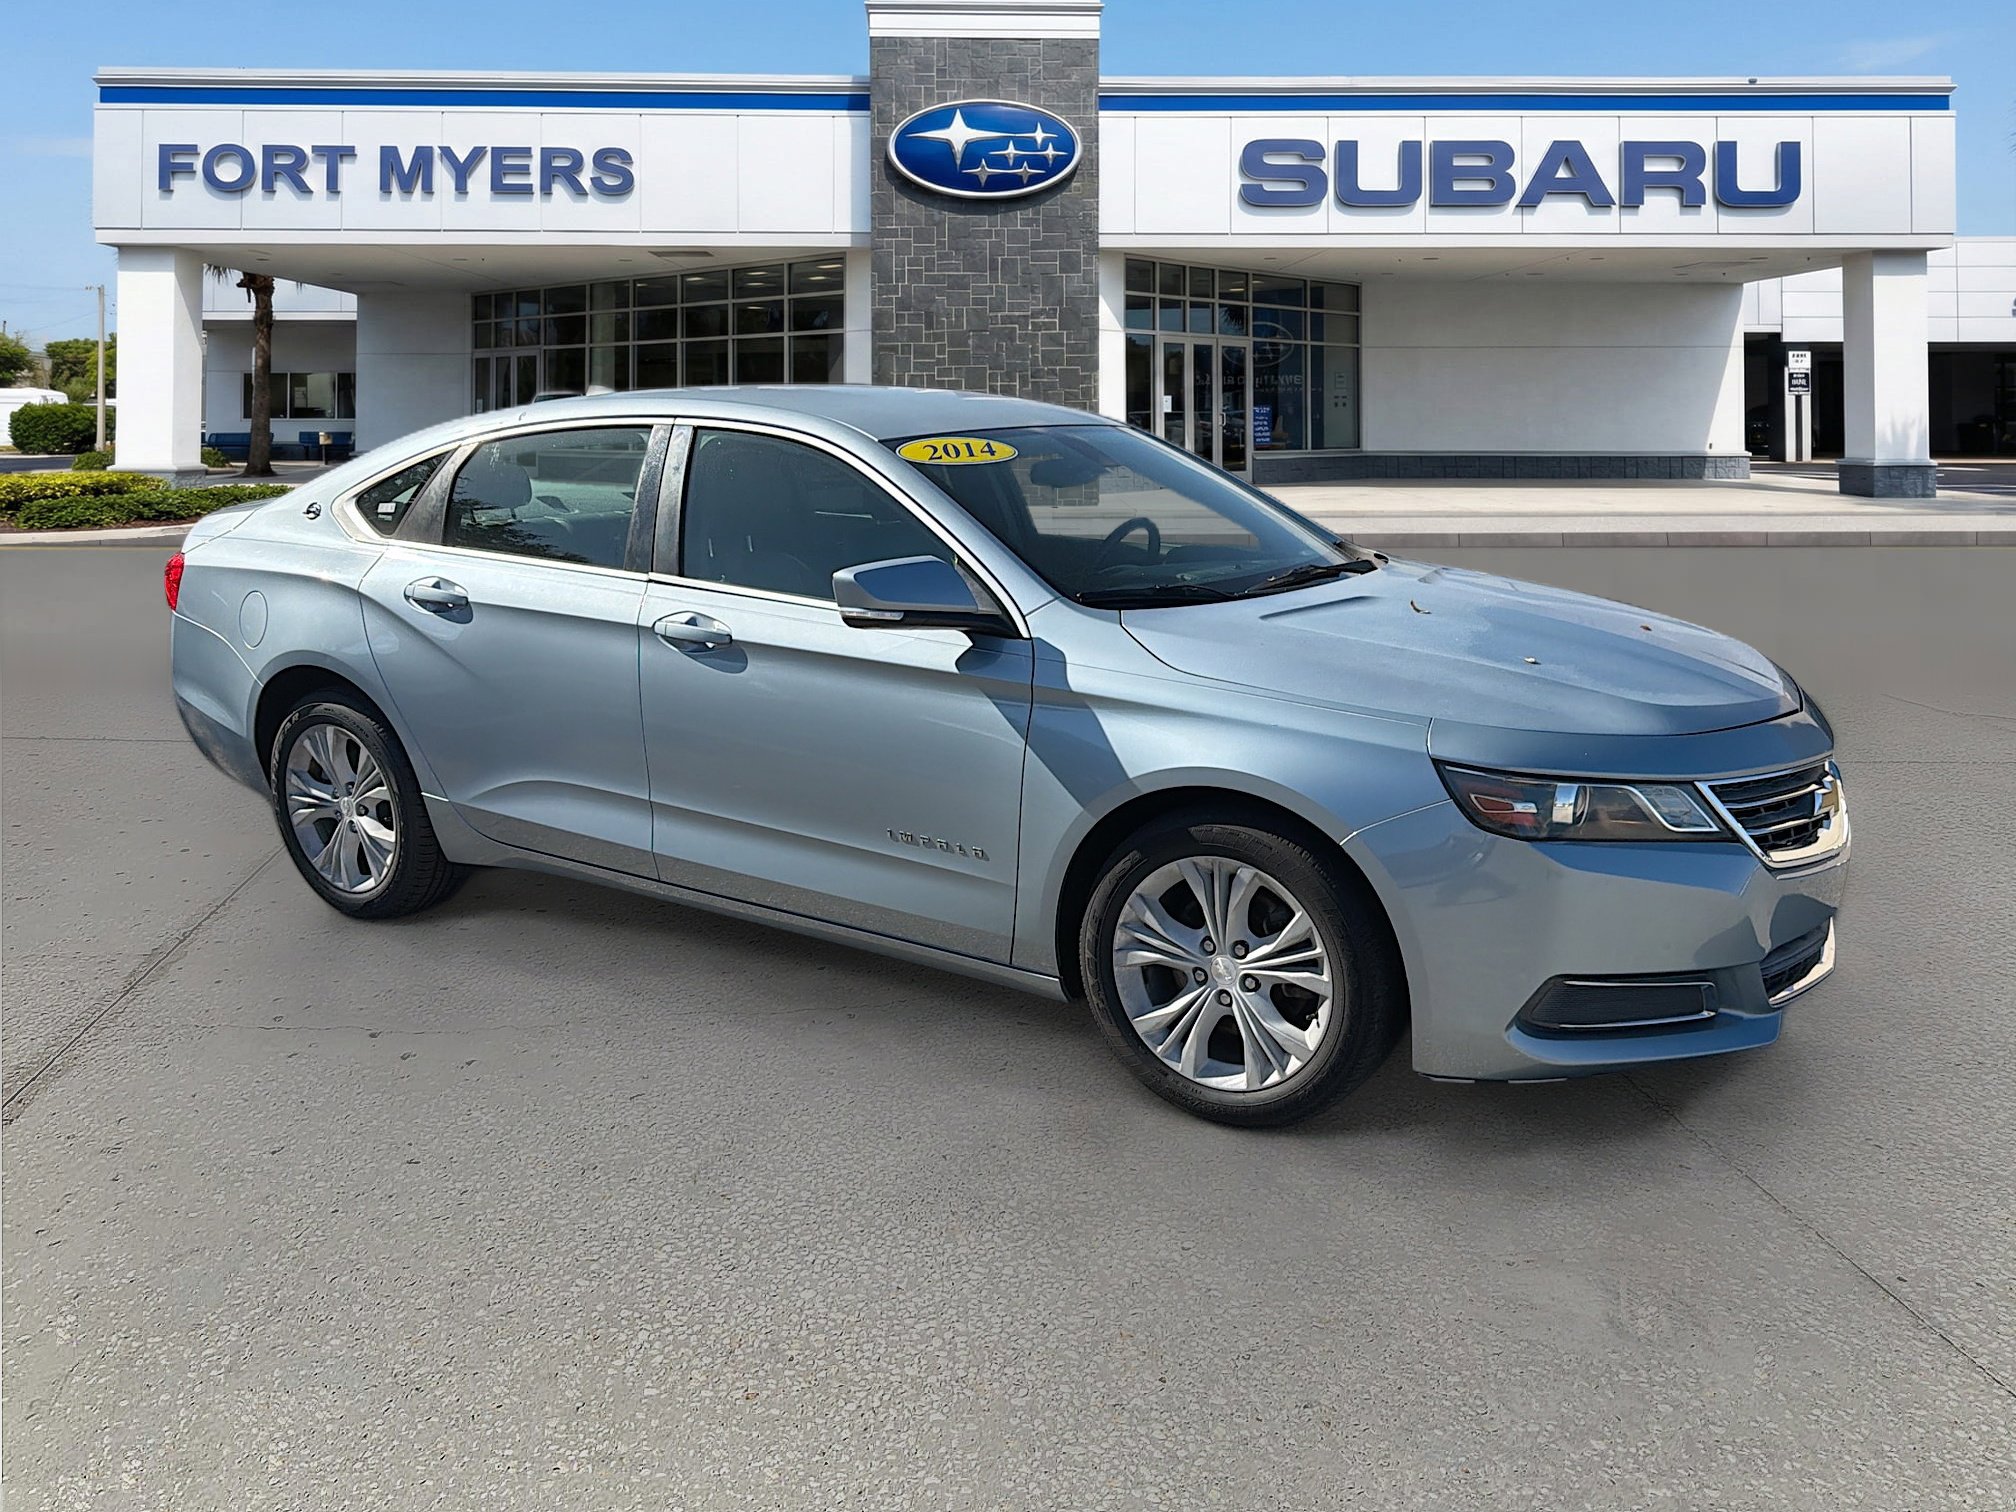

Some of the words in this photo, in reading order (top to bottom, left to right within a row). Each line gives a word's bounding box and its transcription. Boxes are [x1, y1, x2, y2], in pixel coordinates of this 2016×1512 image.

[158, 143, 357, 194] FORT
[379, 145, 635, 196] MYERS
[1239, 138, 1802, 208] SUBARU
[922, 440, 997, 461] 2014
[886, 828, 986, 859] IMPALA
